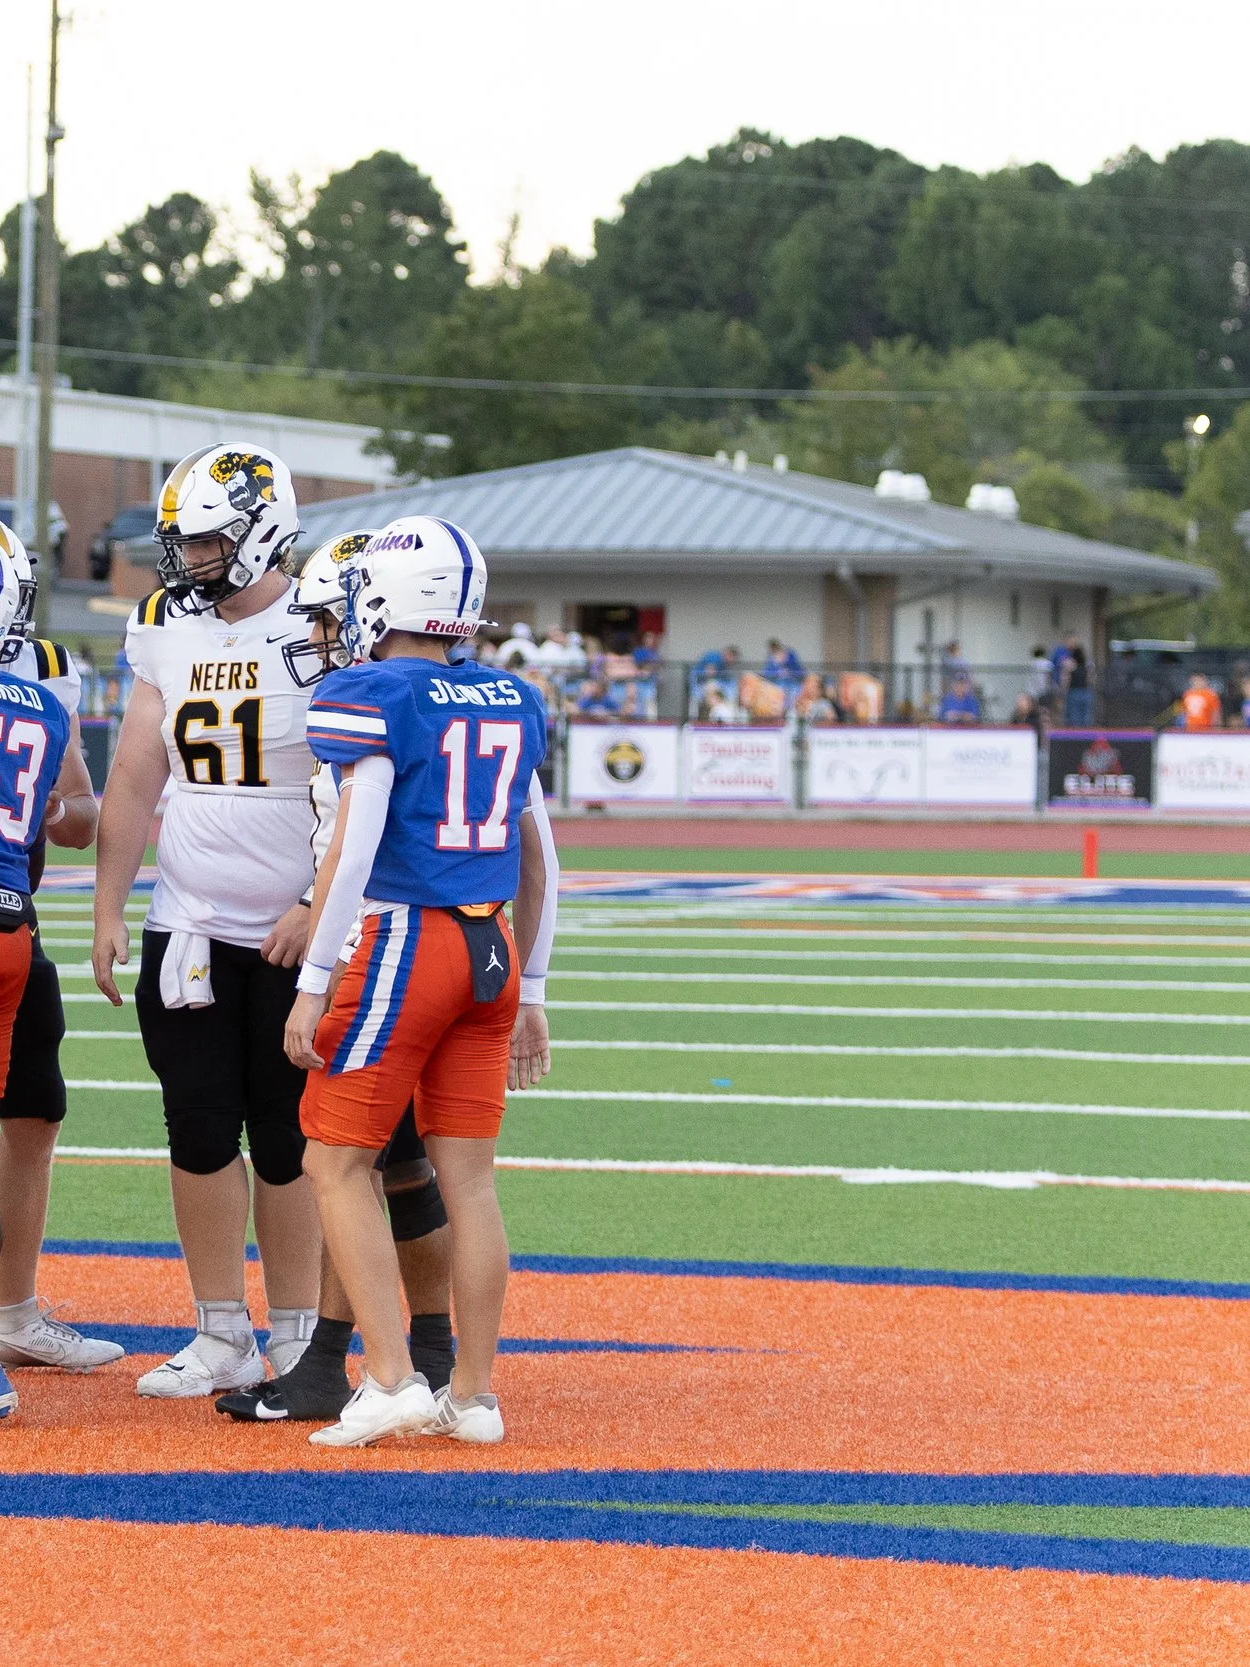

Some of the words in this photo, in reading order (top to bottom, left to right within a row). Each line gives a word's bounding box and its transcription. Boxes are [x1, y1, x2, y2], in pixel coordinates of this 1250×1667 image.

[423, 619, 477, 636] Riddell
[190, 662, 259, 692] NEERS
[429, 678, 522, 706] JONES
[172, 696, 270, 787] 61
[436, 717, 523, 851] 17
